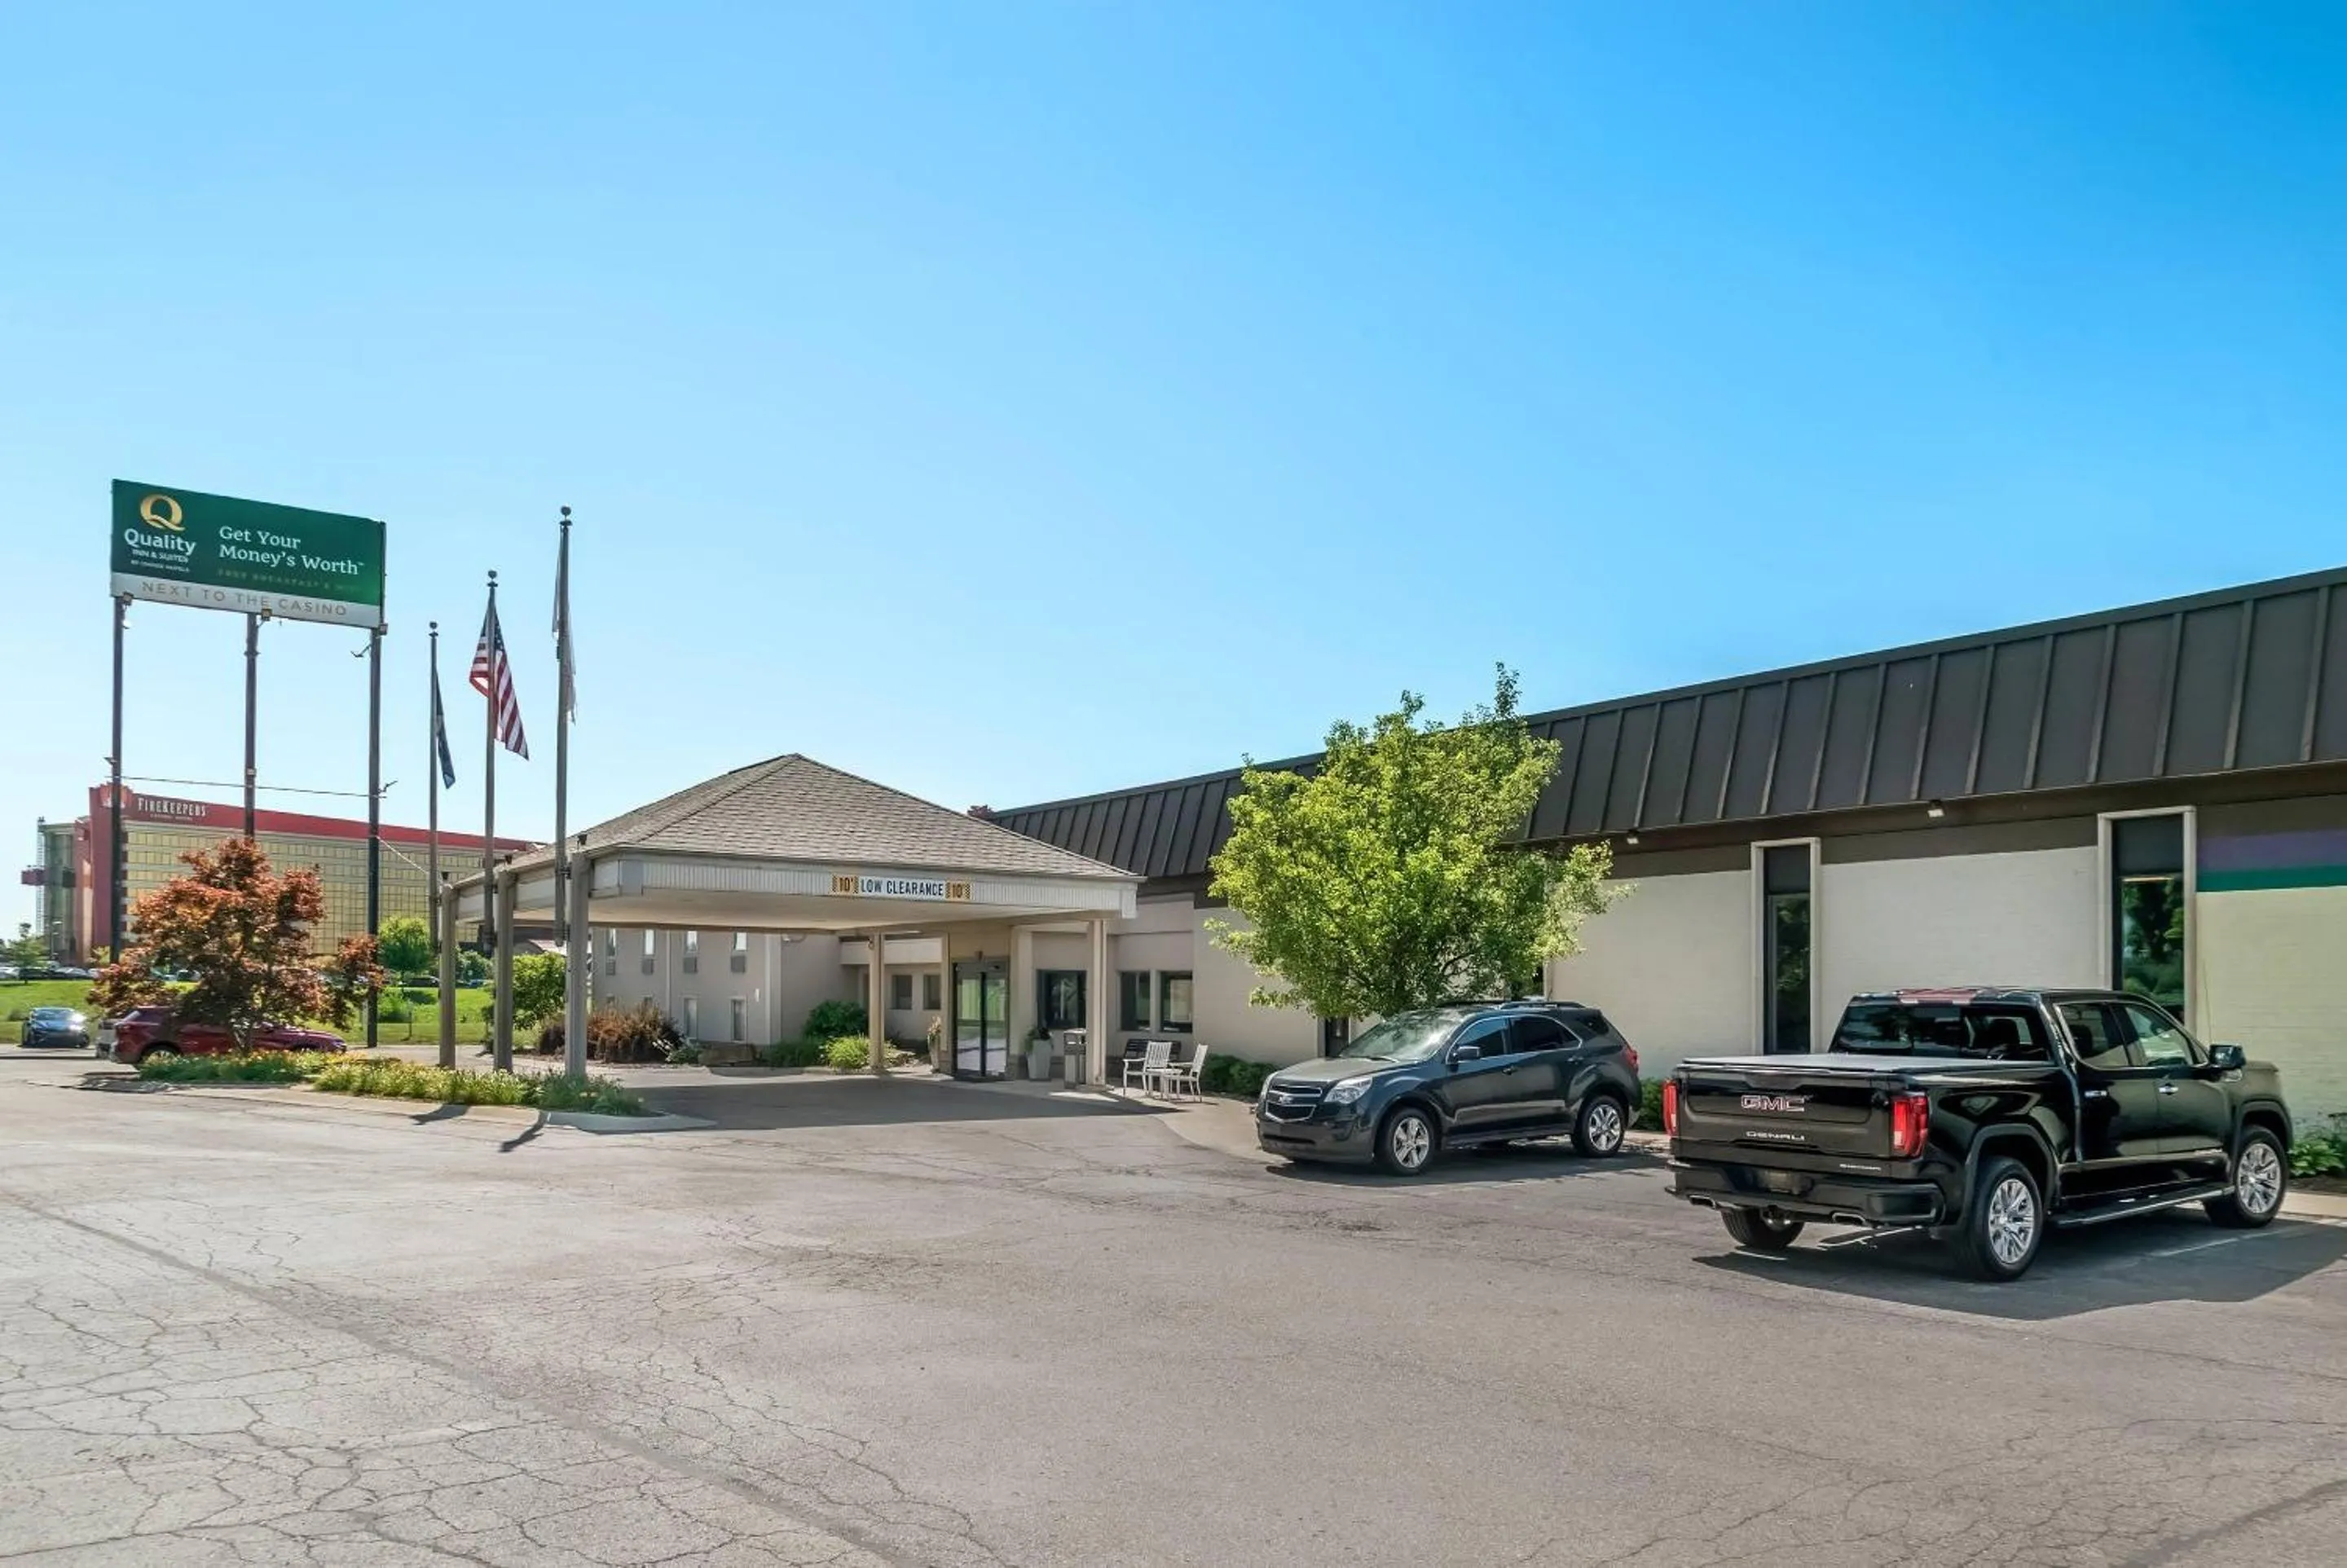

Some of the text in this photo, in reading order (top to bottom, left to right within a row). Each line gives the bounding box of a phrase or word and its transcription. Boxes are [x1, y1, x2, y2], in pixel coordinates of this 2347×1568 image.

[140, 494, 186, 531] Q
[124, 528, 196, 556] Quality
[219, 526, 301, 549] Get Your
[219, 544, 296, 567] Money's
[142, 581, 346, 615] NEXT TO THE CASINO
[861, 879, 883, 892] LOW
[886, 880, 944, 896] CLEARANCE
[1741, 1095, 1804, 1112] GMC
[1746, 1130, 1804, 1141] DENALI
